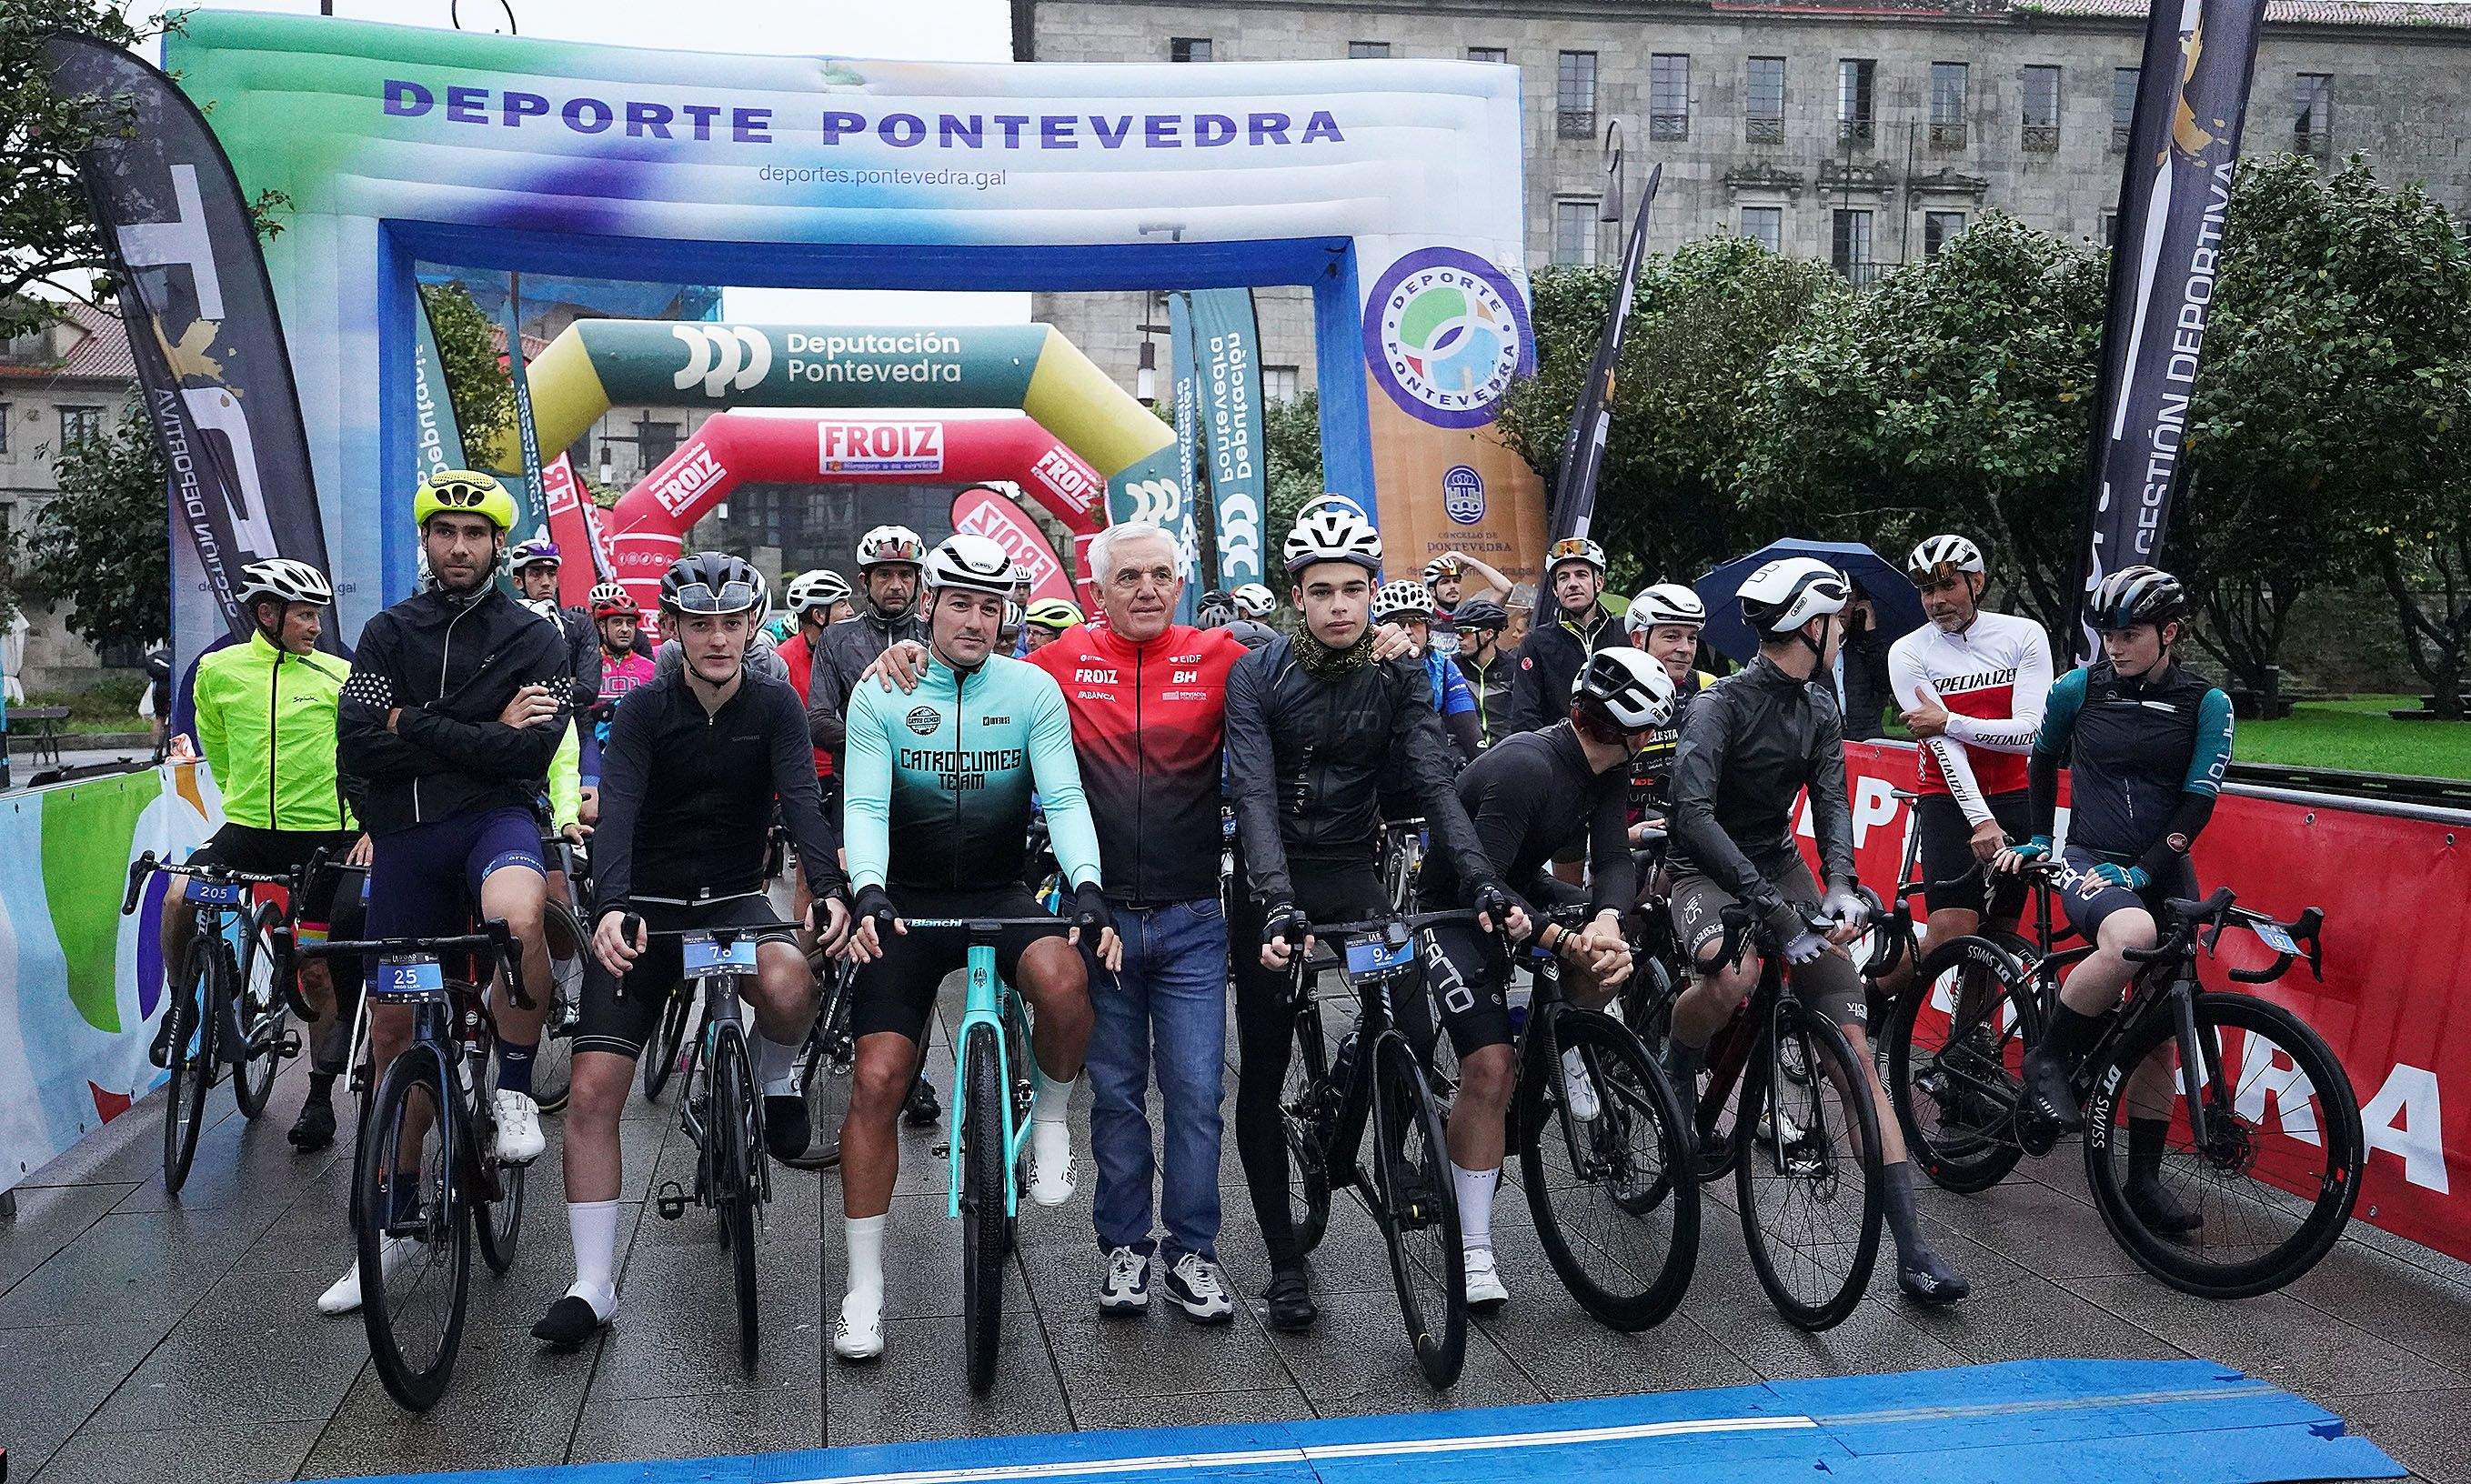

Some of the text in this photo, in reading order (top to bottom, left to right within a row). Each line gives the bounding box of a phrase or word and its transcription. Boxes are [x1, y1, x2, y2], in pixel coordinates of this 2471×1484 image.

[382, 78, 1346, 150] DEPORTE PONTEVEDRA
[758, 162, 1007, 191] deportes.pontevedra.gal
[1391, 272, 1502, 313] DEPORTE
[787, 331, 960, 361] Deputación
[2134, 158, 2237, 556] GESTIÓN DEPORTIVA
[788, 358, 962, 383] Pontevedra
[1387, 342, 1515, 406] PONTEVEDRA
[825, 426, 939, 458] FROIZ
[654, 449, 721, 512] FROIZ
[1038, 450, 1099, 509] FROIZ
[1427, 541, 1512, 554] PONTEVEDRA
[1074, 668, 1119, 685] FROIZ
[1172, 670, 1198, 684] BH
[938, 773, 986, 791] TEAM
[1932, 740, 1970, 802] SPECIALIZED
[199, 886, 228, 899] 205
[910, 918, 963, 928] Bianchi
[1372, 948, 1394, 963] 92
[394, 969, 417, 985] 25
[2092, 1064, 2122, 1148] DT SWISS
